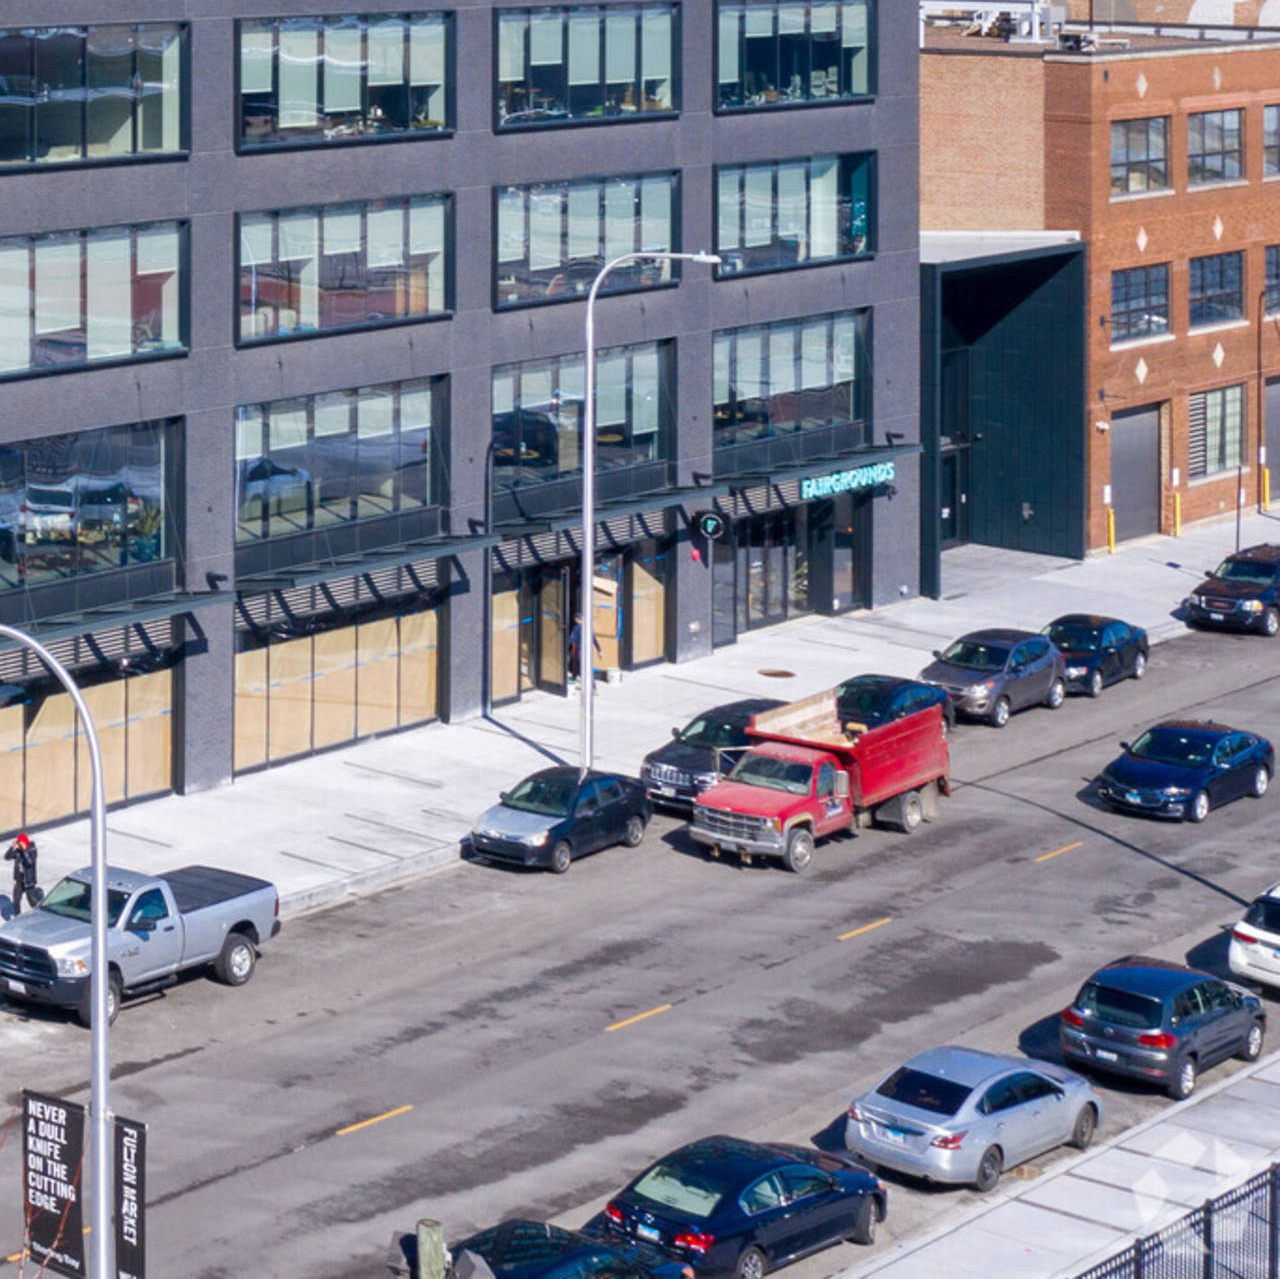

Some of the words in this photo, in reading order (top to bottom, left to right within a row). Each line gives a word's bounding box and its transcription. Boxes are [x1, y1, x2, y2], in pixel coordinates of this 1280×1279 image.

[801, 462, 894, 499] FAIRGROUNDS
[28, 1099, 66, 1126] NEVER
[27, 1118, 36, 1134] A
[39, 1121, 68, 1145] DULL
[28, 1135, 61, 1161] KNIFE
[28, 1153, 43, 1172] ON
[47, 1158, 68, 1181] THE
[28, 1170, 76, 1202] CUTTING
[28, 1187, 61, 1215] EDGE.
